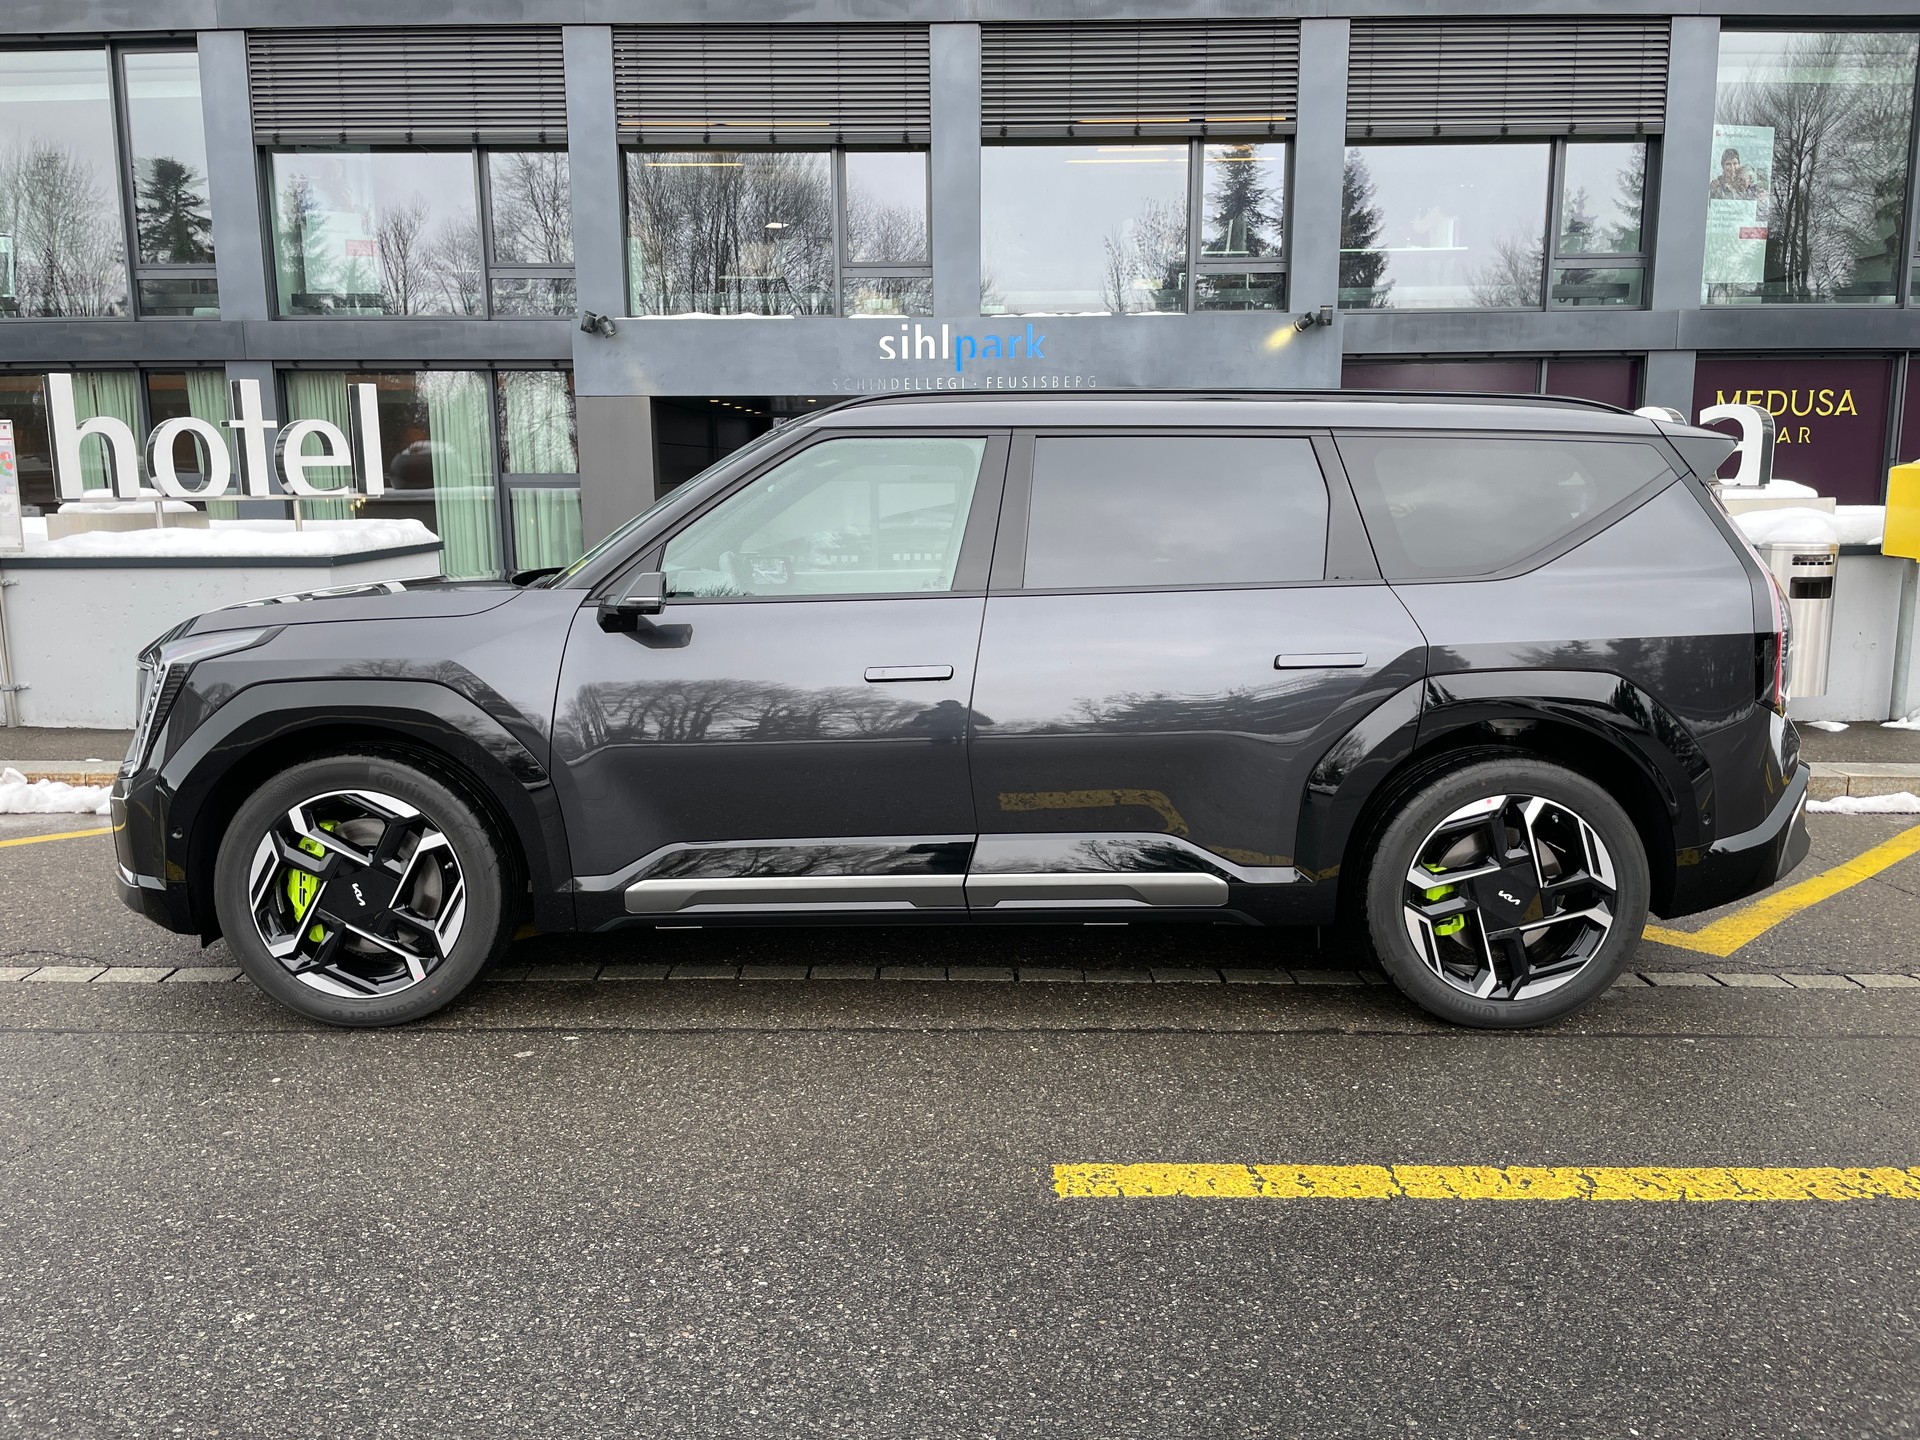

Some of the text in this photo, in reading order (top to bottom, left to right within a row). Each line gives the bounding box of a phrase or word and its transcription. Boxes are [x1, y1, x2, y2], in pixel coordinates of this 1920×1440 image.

[879, 322, 1046, 373] sihlpark
[832, 375, 1097, 391] SCHINDELLEGI FEUSISBERG
[43, 372, 384, 500] hotel
[1776, 426, 1812, 444] AR
